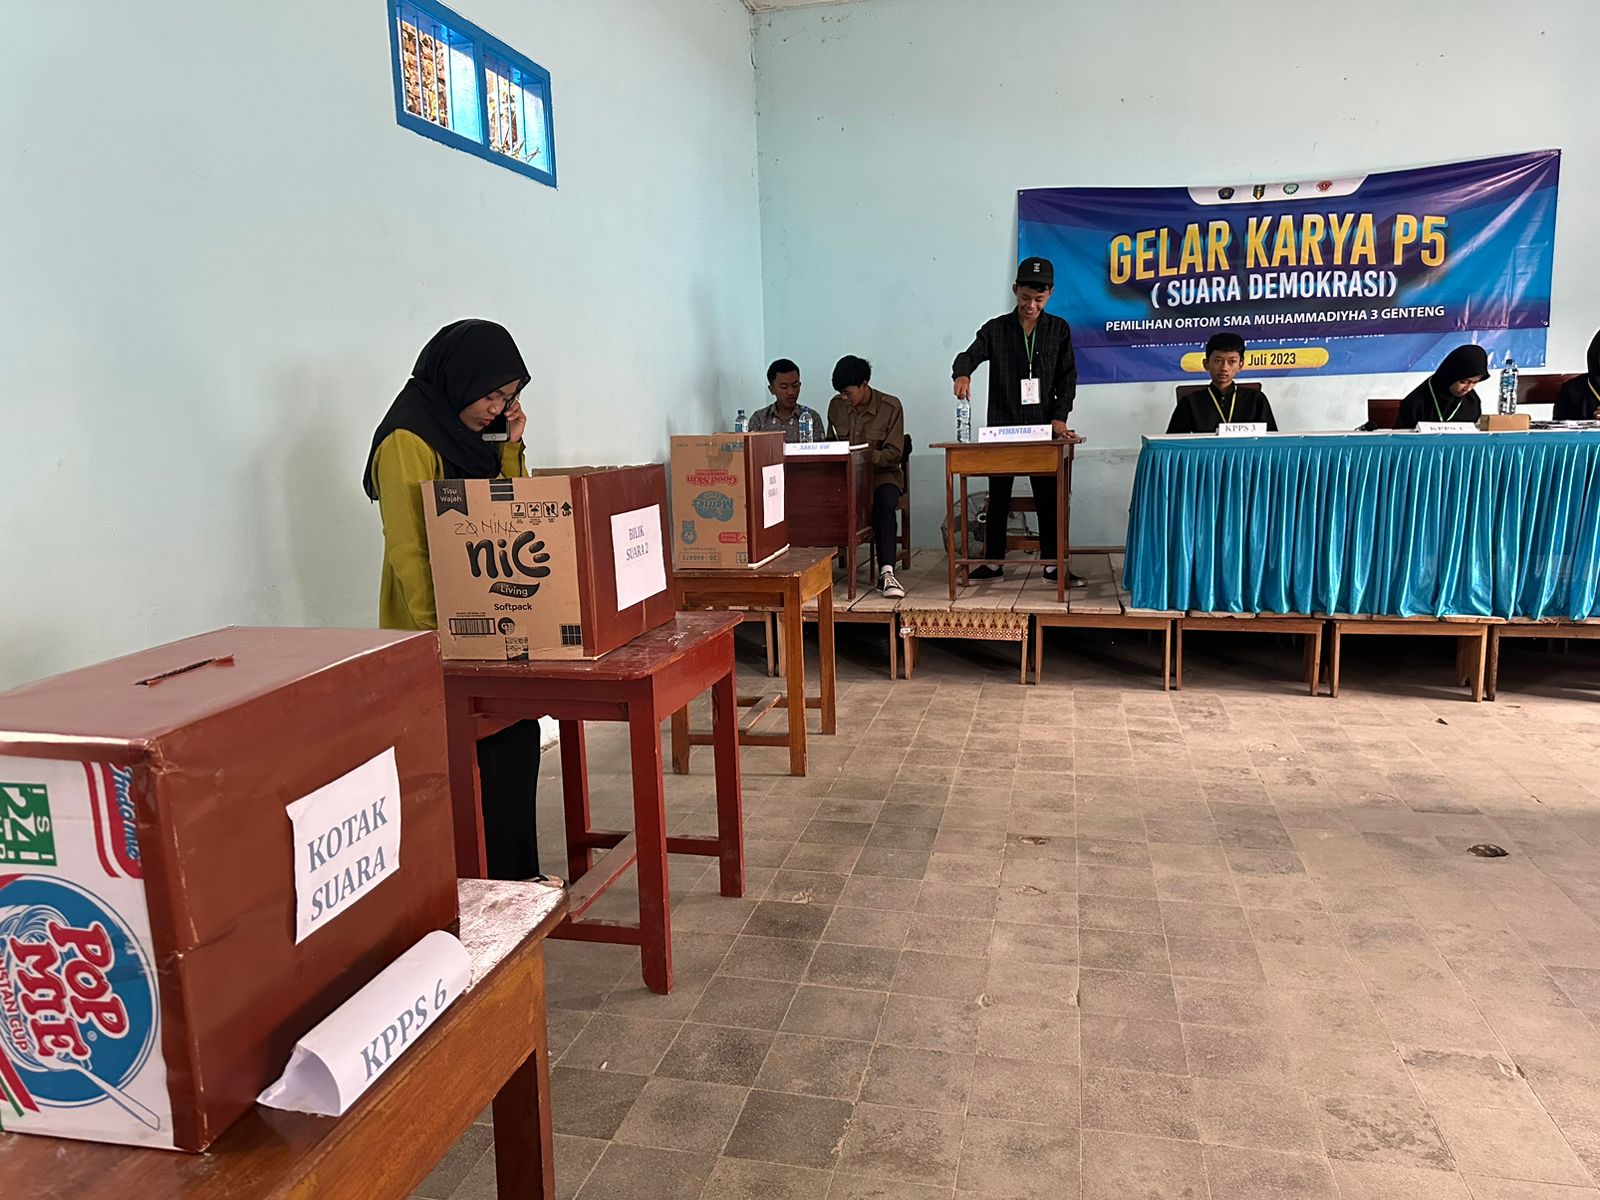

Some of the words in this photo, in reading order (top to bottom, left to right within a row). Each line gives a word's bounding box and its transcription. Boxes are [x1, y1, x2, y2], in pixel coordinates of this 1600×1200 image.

[1110, 219, 1230, 285] GELAR
[1246, 213, 1377, 269] KARYA
[1393, 213, 1446, 267] P5
[1167, 275, 1241, 307] SUARA
[1248, 270, 1397, 300] DEMOKRASI)
[1105, 319, 1173, 332] PEMILIHAN
[1175, 316, 1220, 329] ORTOM
[1223, 315, 1251, 327] SMA
[1254, 309, 1368, 326] MUHAMMADIYHA
[1370, 309, 1378, 320] 3
[1380, 305, 1445, 319] GENTENG
[1247, 353, 1267, 367] Juli
[1269, 352, 1296, 366] 2023
[1225, 424, 1249, 432] KPPS
[1251, 424, 1256, 432] 3
[628, 525, 645, 540] BILIK
[626, 544, 645, 561] SUARA
[494, 602, 533, 612] Softpack
[500, 585, 528, 597] Living
[2, 786, 37, 852] 24
[307, 796, 388, 874] KOTAK
[311, 845, 386, 922] SUARA
[10, 936, 89, 1057] MIE
[48, 921, 127, 1035] POP
[360, 995, 428, 1081] KPPS
[434, 978, 447, 1011] 6
